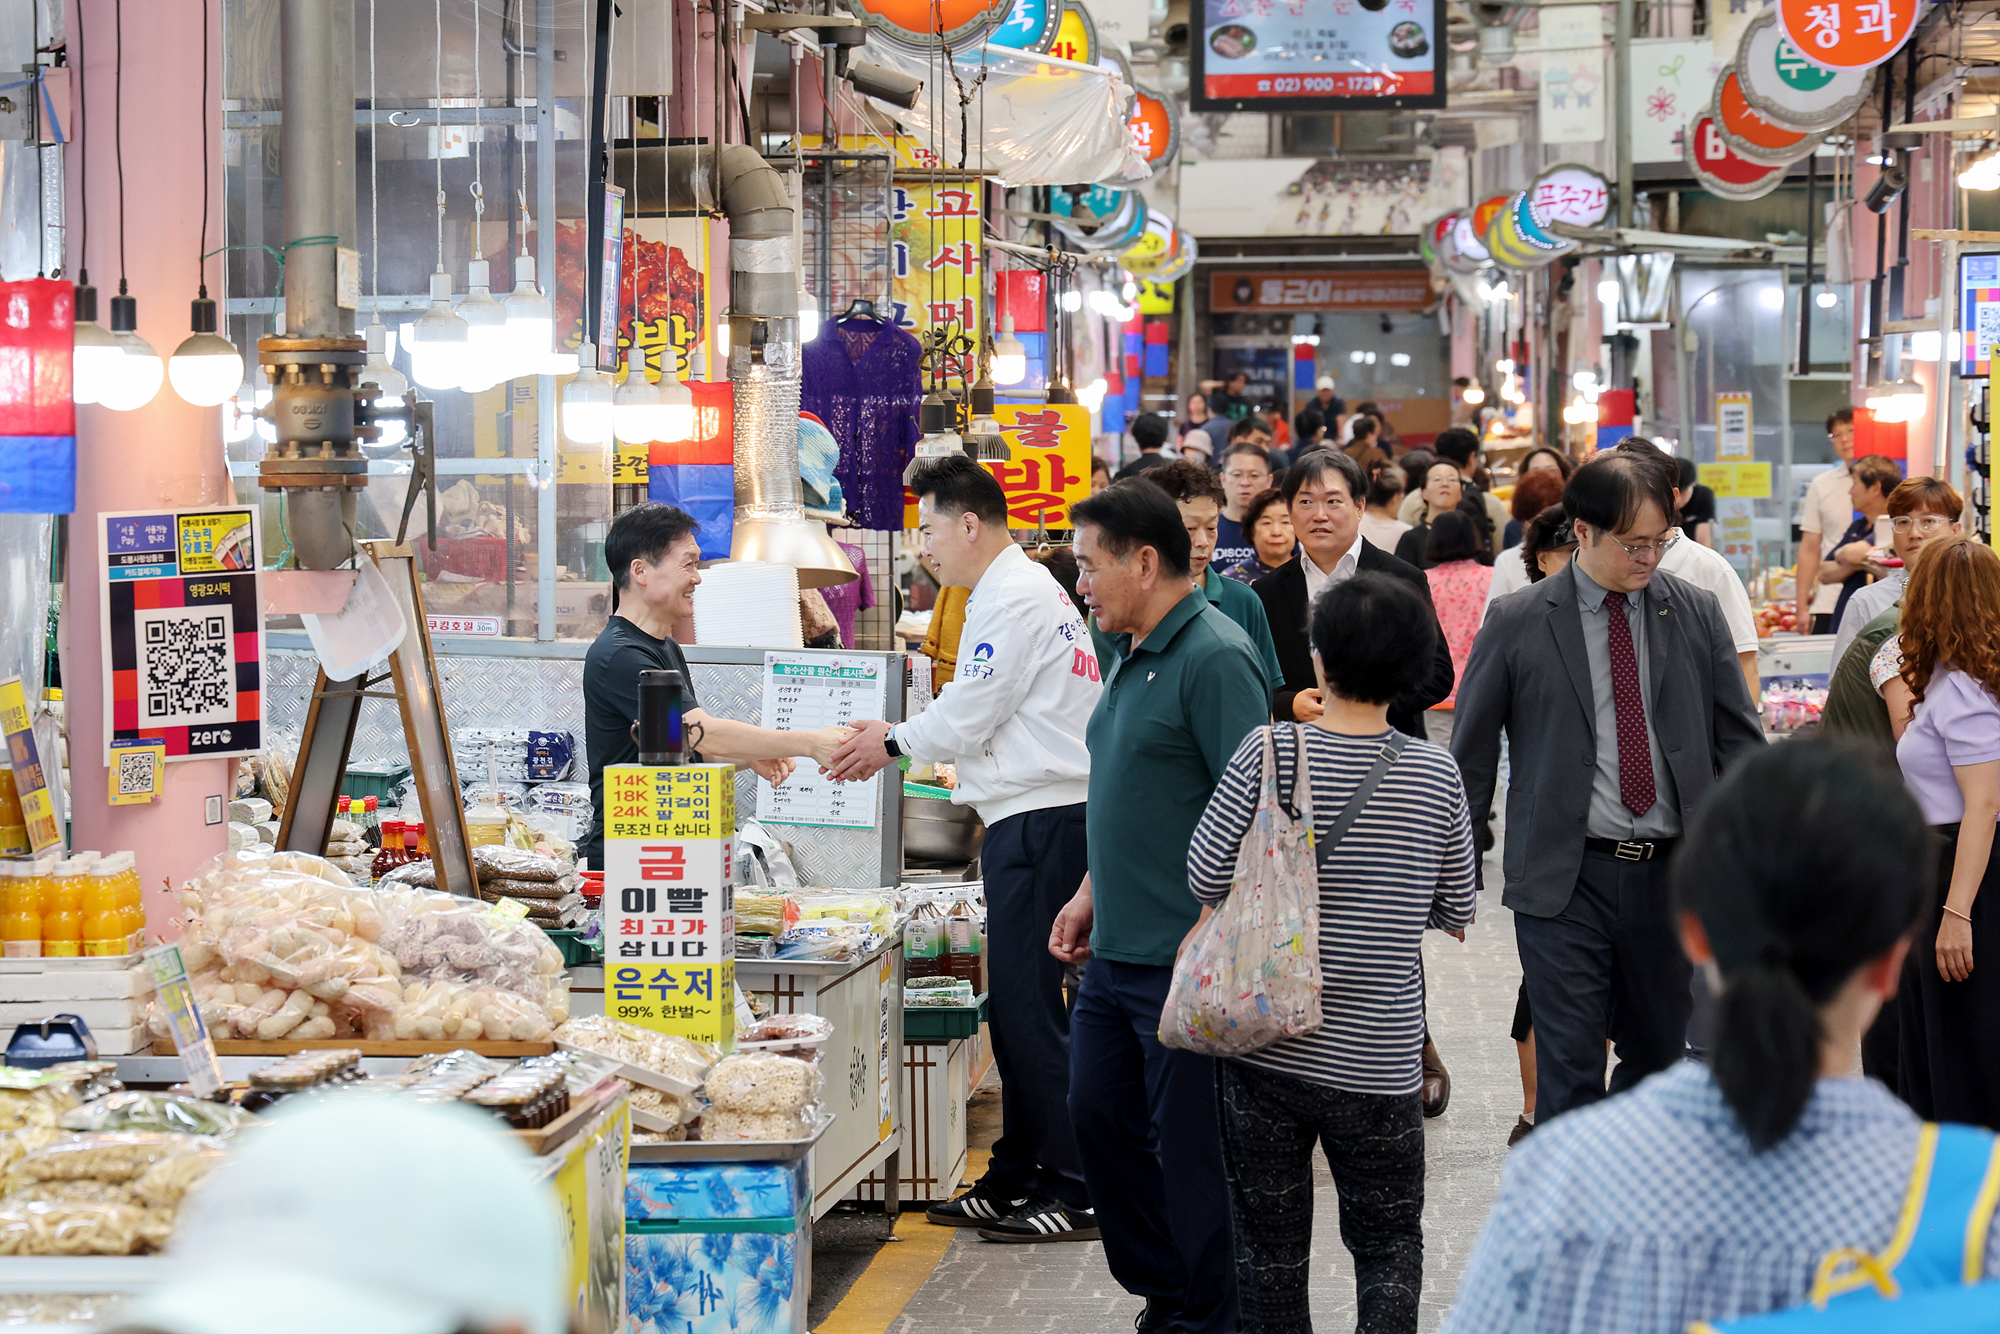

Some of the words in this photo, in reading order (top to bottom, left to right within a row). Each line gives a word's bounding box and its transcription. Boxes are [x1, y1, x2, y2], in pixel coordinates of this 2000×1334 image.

[1303, 77, 1334, 92] 900
[120, 525, 135, 536] 서울
[182, 528, 212, 541] 온누리
[121, 535, 135, 547] Pay
[182, 540, 213, 555] 상품권
[189, 582, 231, 598] 영광모시떡
[428, 620, 474, 632] 쿠킹호일
[783, 665, 815, 676] 농수산물
[962, 663, 994, 680] 도봉구
[613, 774, 649, 787] 14K
[655, 772, 709, 783] 목걸이
[613, 790, 649, 802] 18K
[655, 797, 709, 808] 귀걸이
[613, 806, 649, 818] 24K
[613, 823, 651, 836] 무조건
[656, 823, 669, 836] 다
[673, 823, 711, 836] 삽니다
[638, 846, 686, 880] 금
[621, 887, 708, 913] 이빨
[620, 918, 708, 936] 최고가
[618, 941, 708, 957] 삽니다
[613, 968, 713, 1002] 은수저
[617, 1005, 654, 1018] 99%
